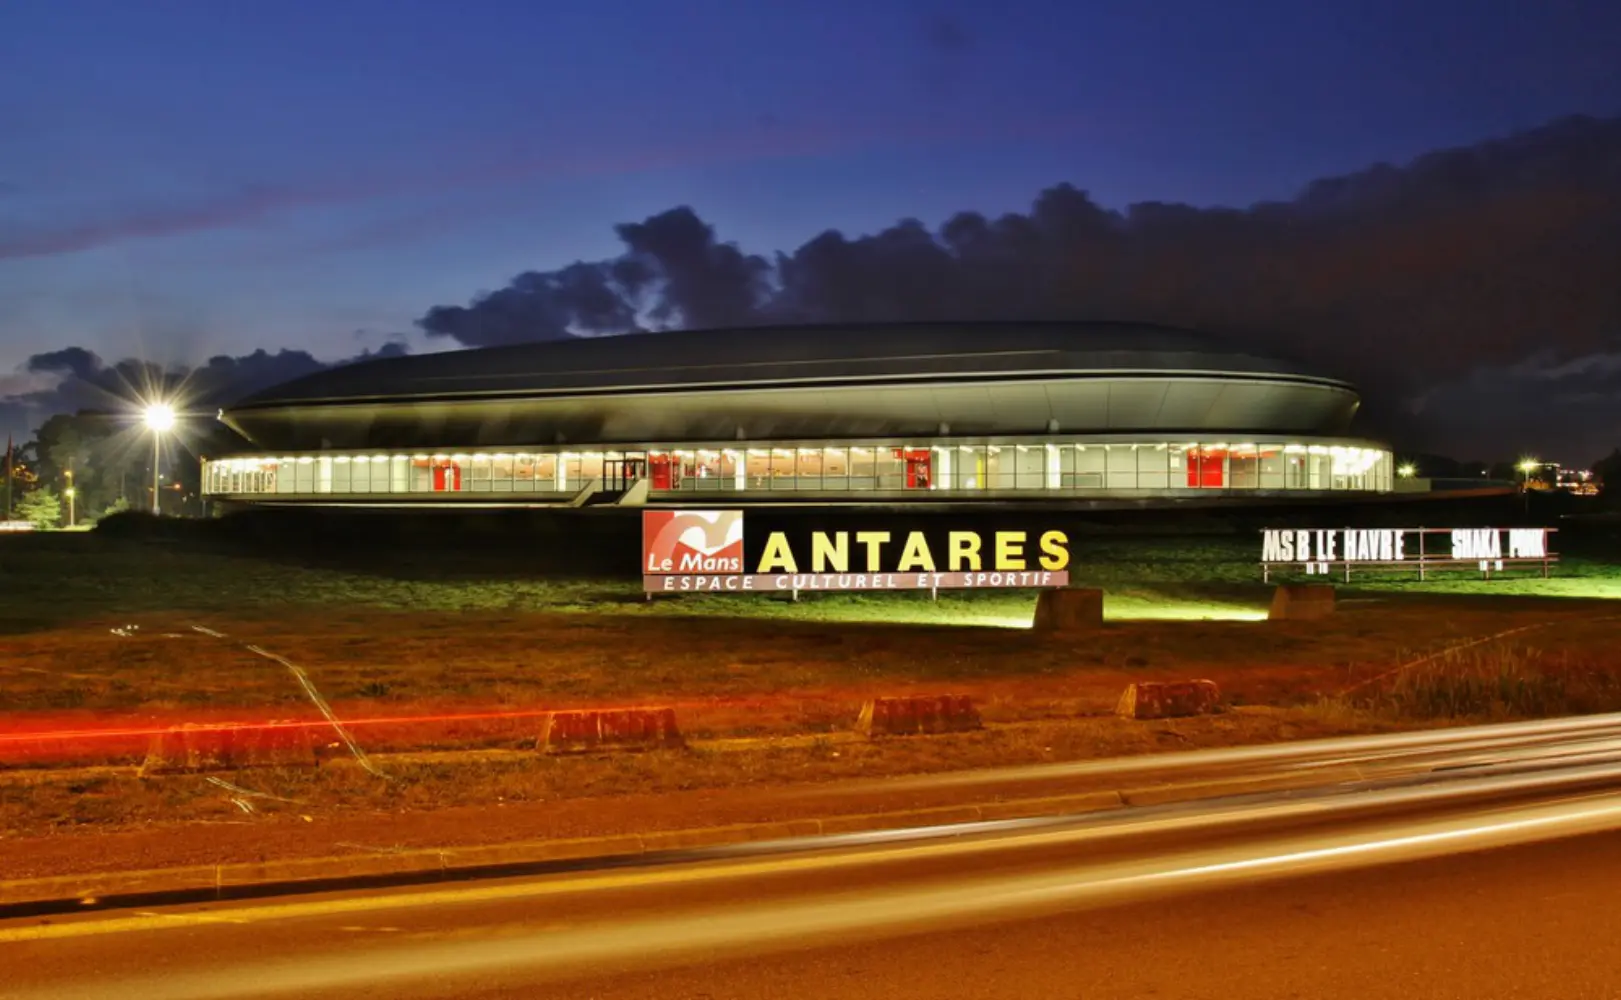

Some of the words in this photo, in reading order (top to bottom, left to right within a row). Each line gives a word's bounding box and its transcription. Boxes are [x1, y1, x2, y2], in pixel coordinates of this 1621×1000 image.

[756, 530, 1070, 573] ANTARES
[1316, 529, 1337, 561] LE
[1343, 529, 1405, 561] HAVRE
[647, 553, 673, 571] Le
[679, 554, 740, 571] Mans
[663, 575, 754, 591] ESPACE
[775, 573, 897, 589] CULTUREL
[917, 573, 943, 588] ET
[963, 571, 1053, 586] SPORTIF
